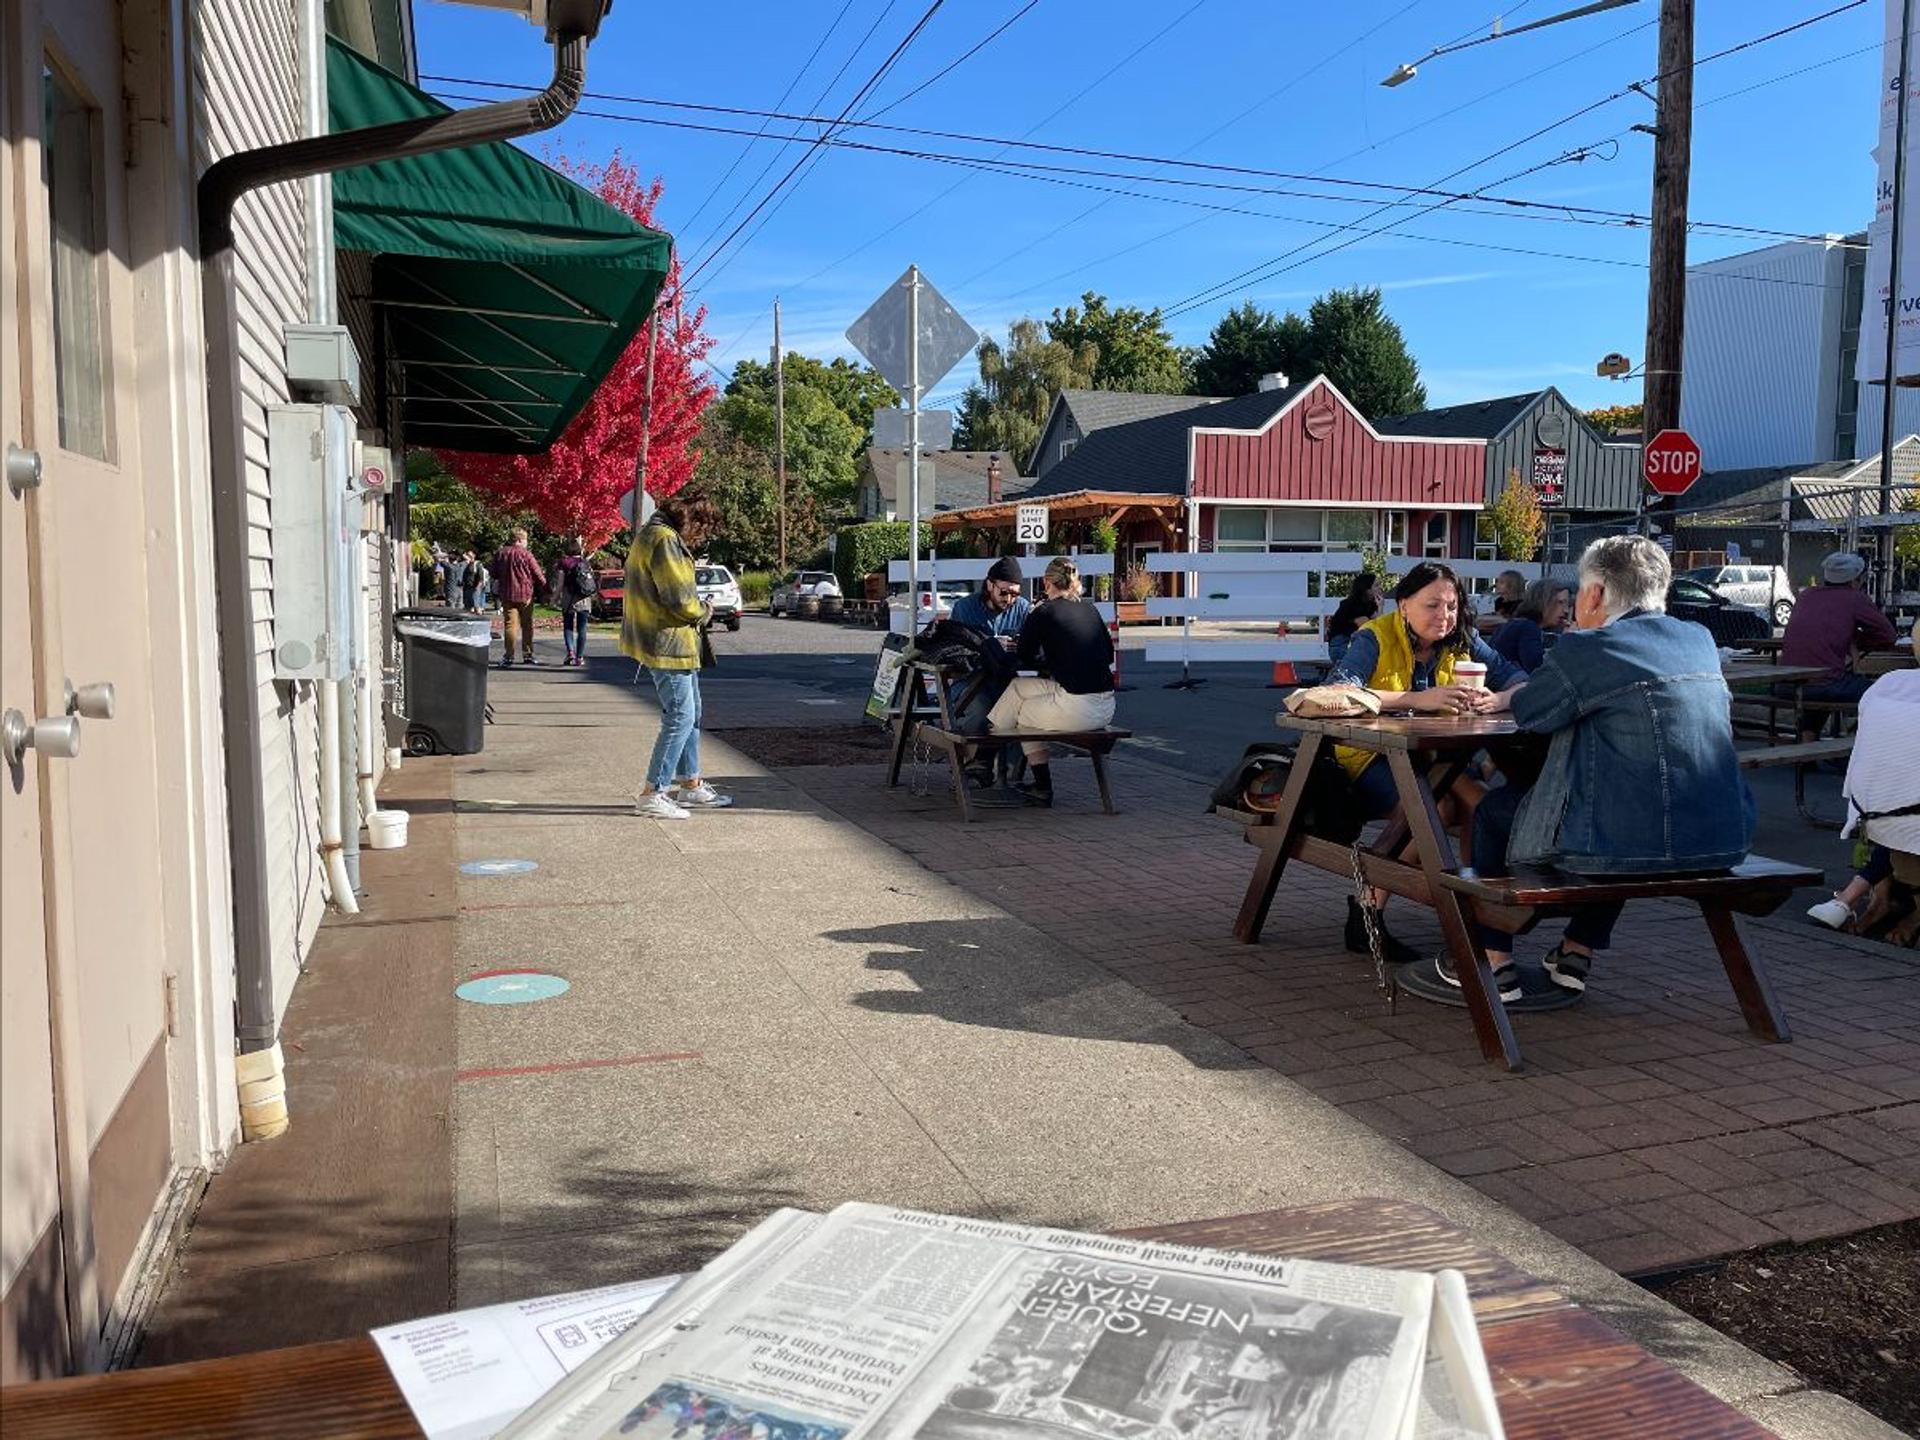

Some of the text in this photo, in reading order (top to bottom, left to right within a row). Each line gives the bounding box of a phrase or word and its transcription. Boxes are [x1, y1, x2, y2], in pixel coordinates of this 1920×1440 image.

[1648, 450, 1697, 474] STOP
[1021, 524, 1045, 539] 20
[1047, 1233, 1137, 1255] campaign
[1142, 1245, 1198, 1264] recall
[1203, 1254, 1284, 1278] Wheeler
[725, 1324, 788, 1346] Festival
[790, 1337, 830, 1357] Film
[772, 1348, 838, 1374] viewing
[830, 1346, 907, 1376] Portland
[749, 1361, 882, 1405] Documentaries
[842, 1366, 893, 1388] worth
